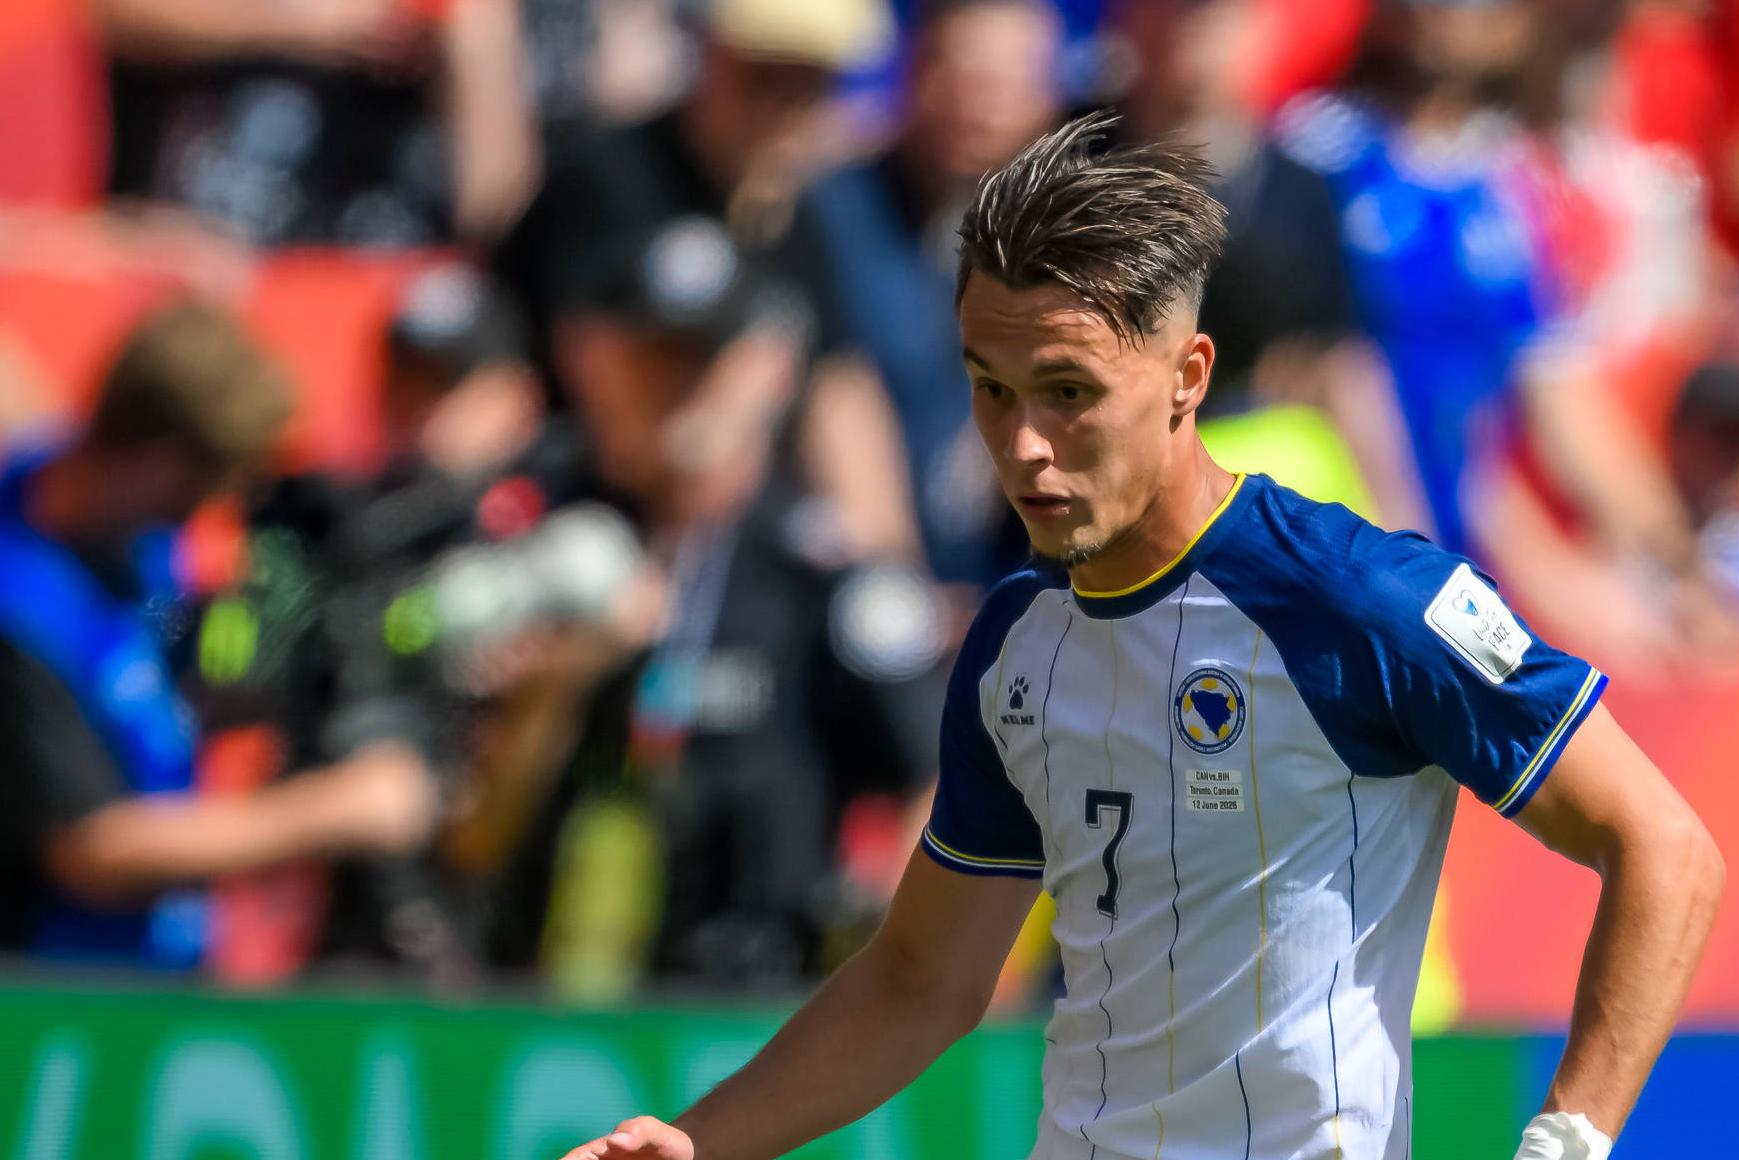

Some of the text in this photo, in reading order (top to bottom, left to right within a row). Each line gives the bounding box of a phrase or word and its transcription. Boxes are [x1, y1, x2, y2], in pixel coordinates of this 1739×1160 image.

[1193, 800, 1201, 809] 12
[1202, 800, 1218, 810] June
[1085, 788, 1134, 920] 7
